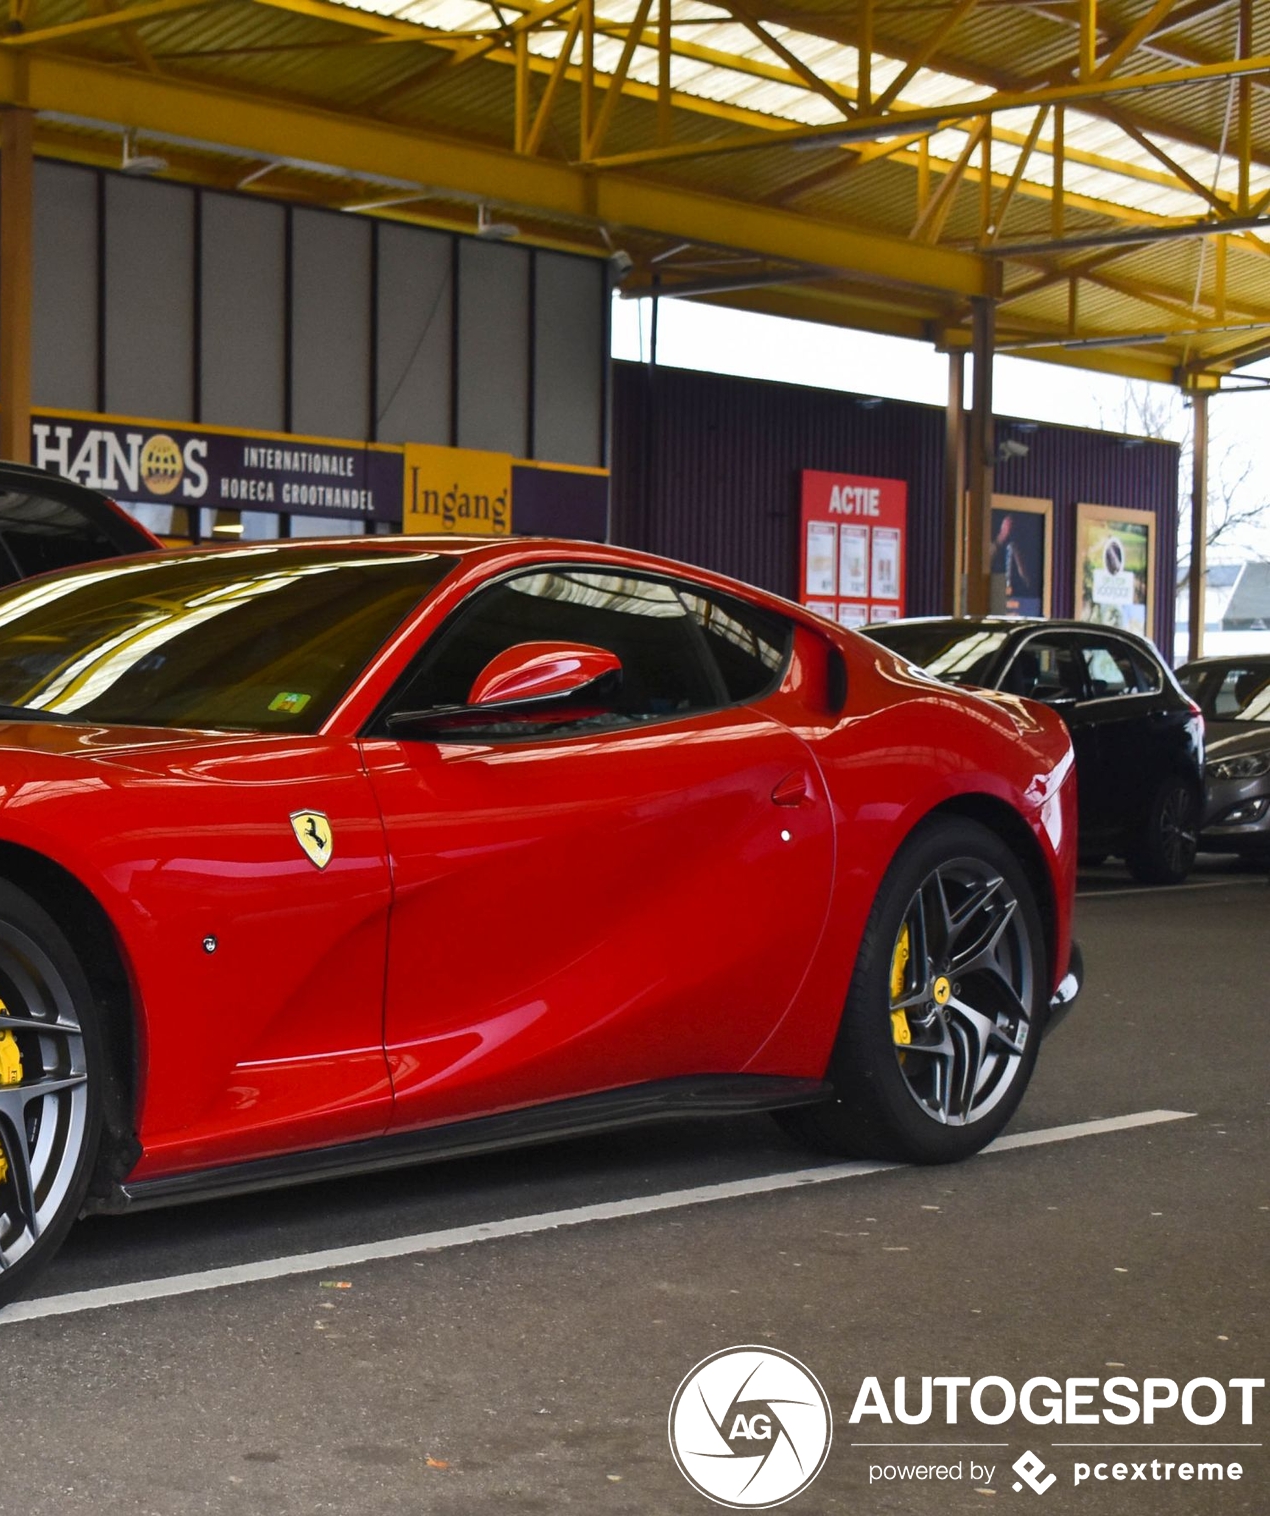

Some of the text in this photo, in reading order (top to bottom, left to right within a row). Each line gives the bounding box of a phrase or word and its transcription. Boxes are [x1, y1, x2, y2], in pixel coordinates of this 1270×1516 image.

[33, 424, 209, 498] HANOS
[243, 447, 355, 477] INTERNATIONALE
[220, 477, 375, 511] HORECA GROOTHANDEL
[411, 466, 508, 534] Ingang
[829, 484, 880, 517] ACTIE
